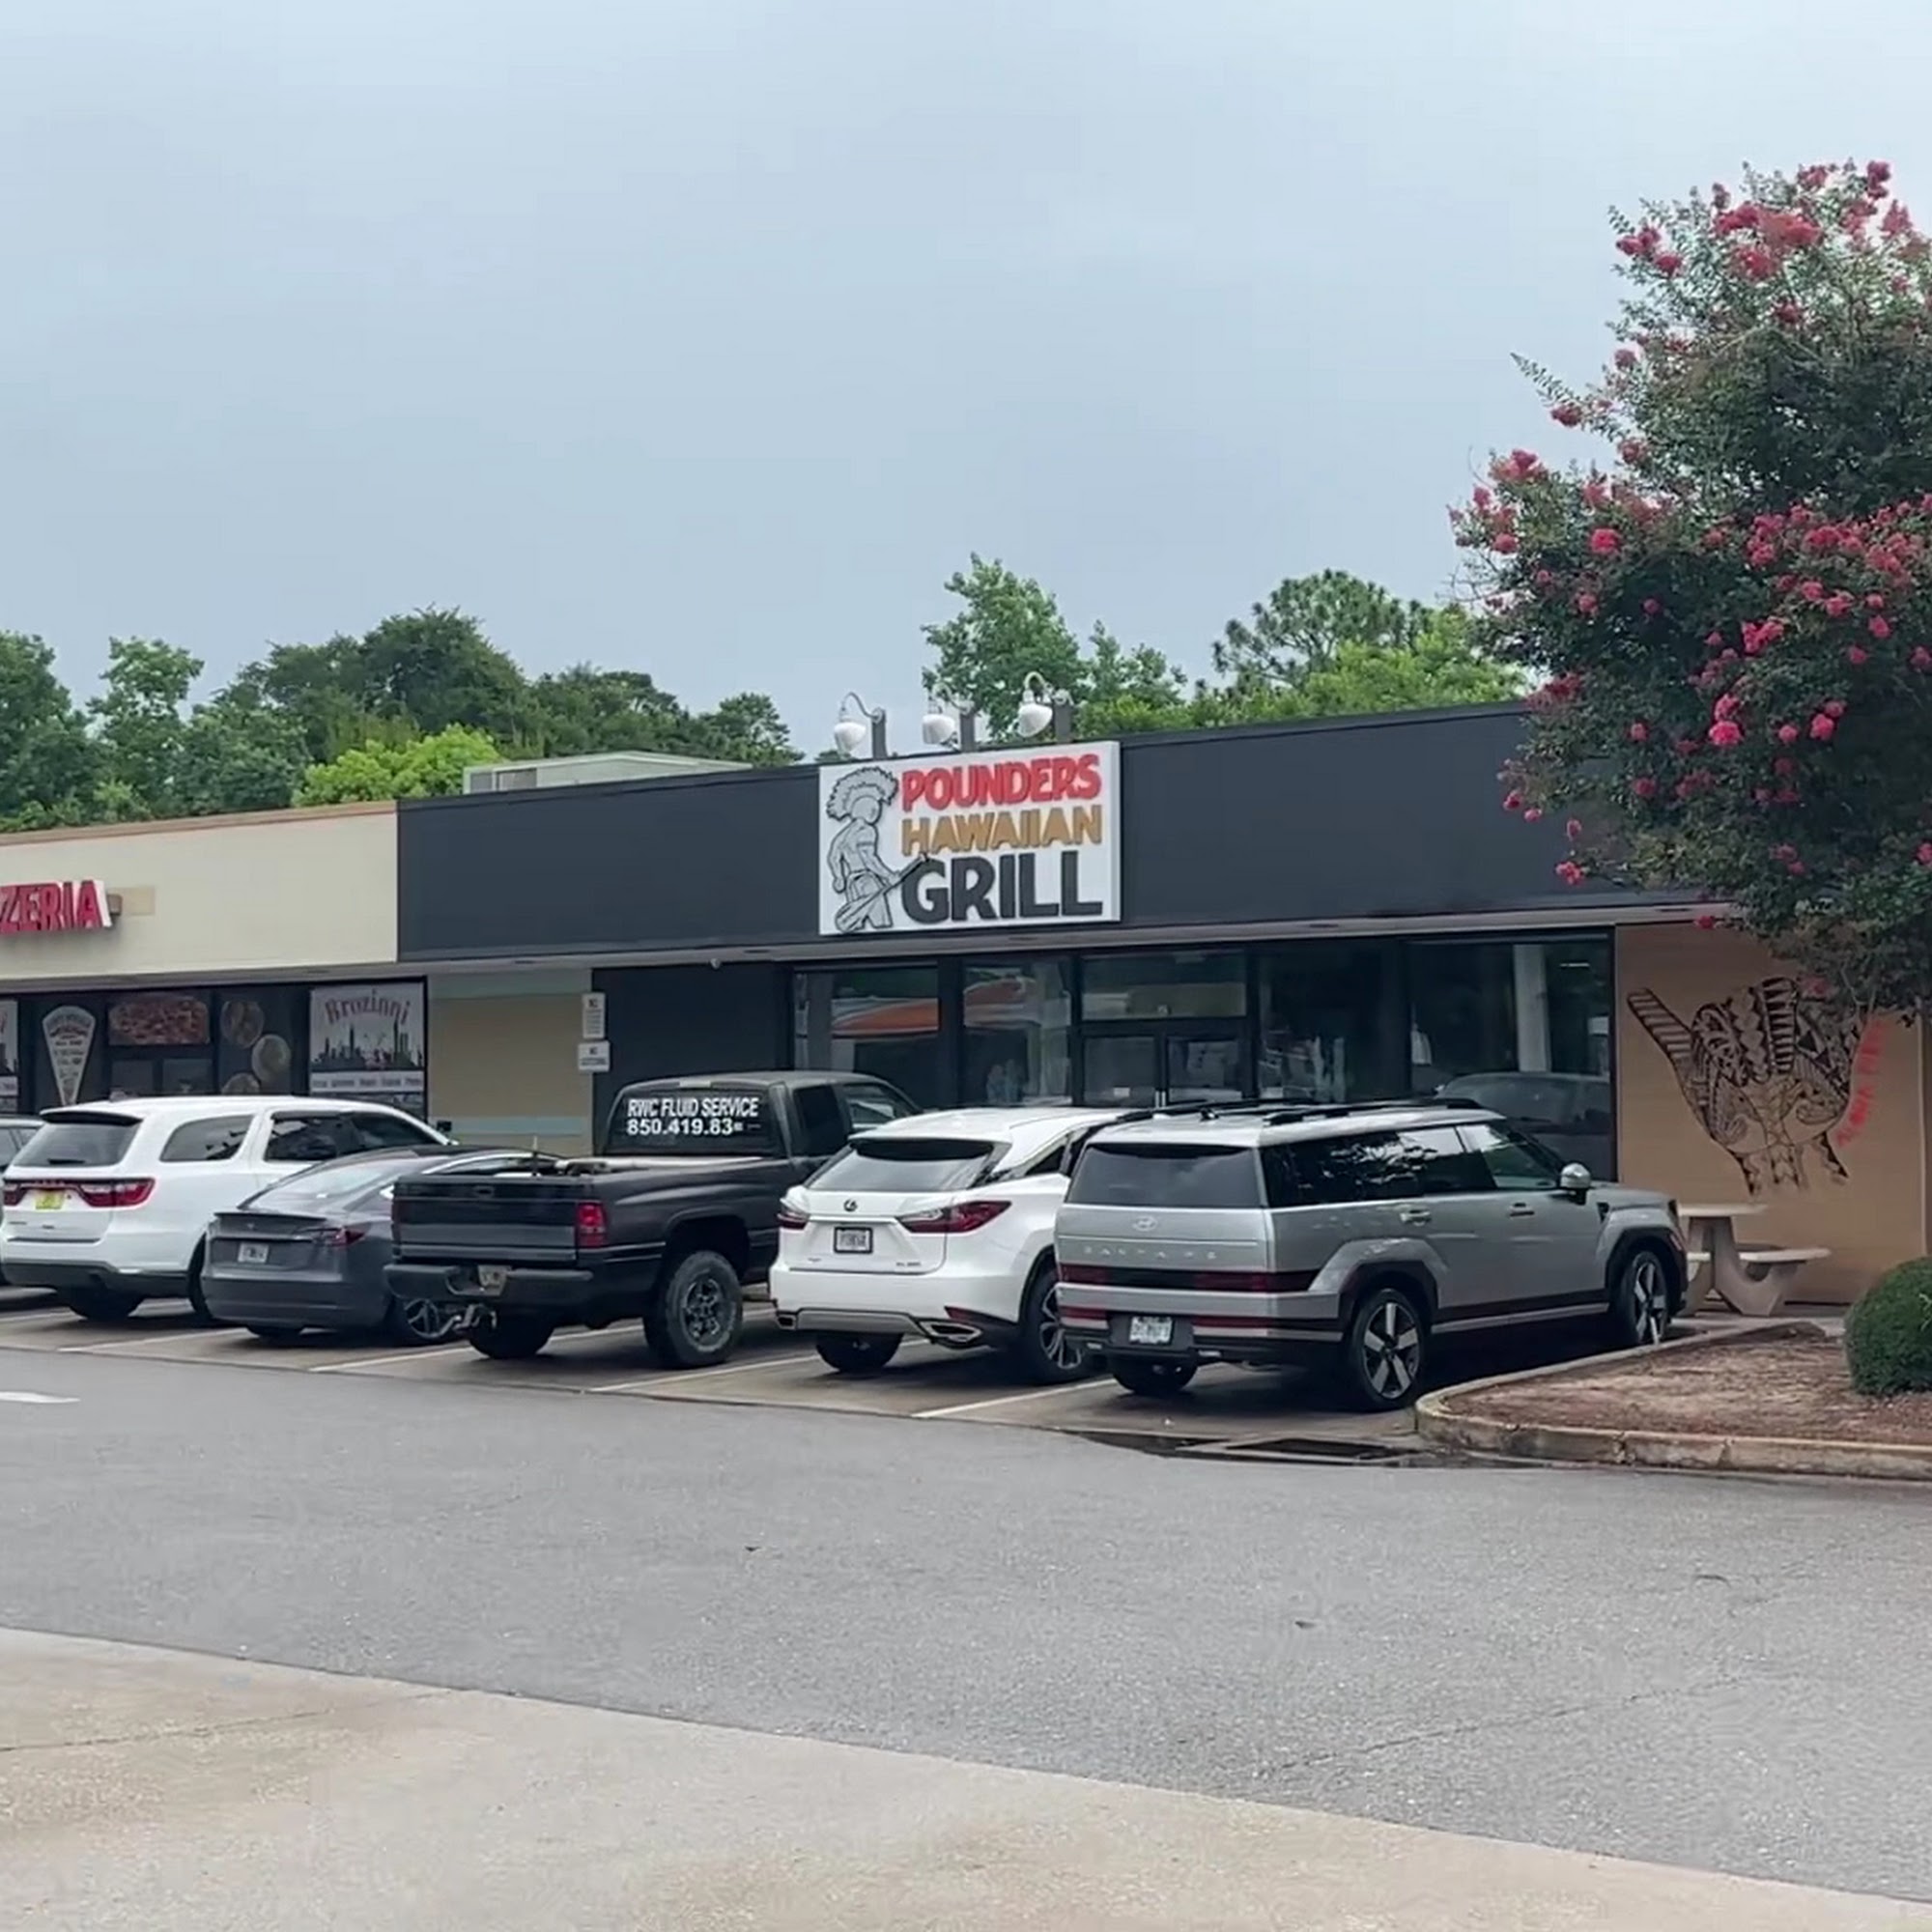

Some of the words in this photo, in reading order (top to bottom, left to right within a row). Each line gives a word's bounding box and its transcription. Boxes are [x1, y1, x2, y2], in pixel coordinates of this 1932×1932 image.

[902, 753, 1101, 812] POUNDERS
[901, 805, 1102, 856] HAWAIIAN
[901, 850, 1103, 924] GRILL
[661, 1097, 698, 1118] FLUID
[701, 1097, 759, 1118] SERVICE
